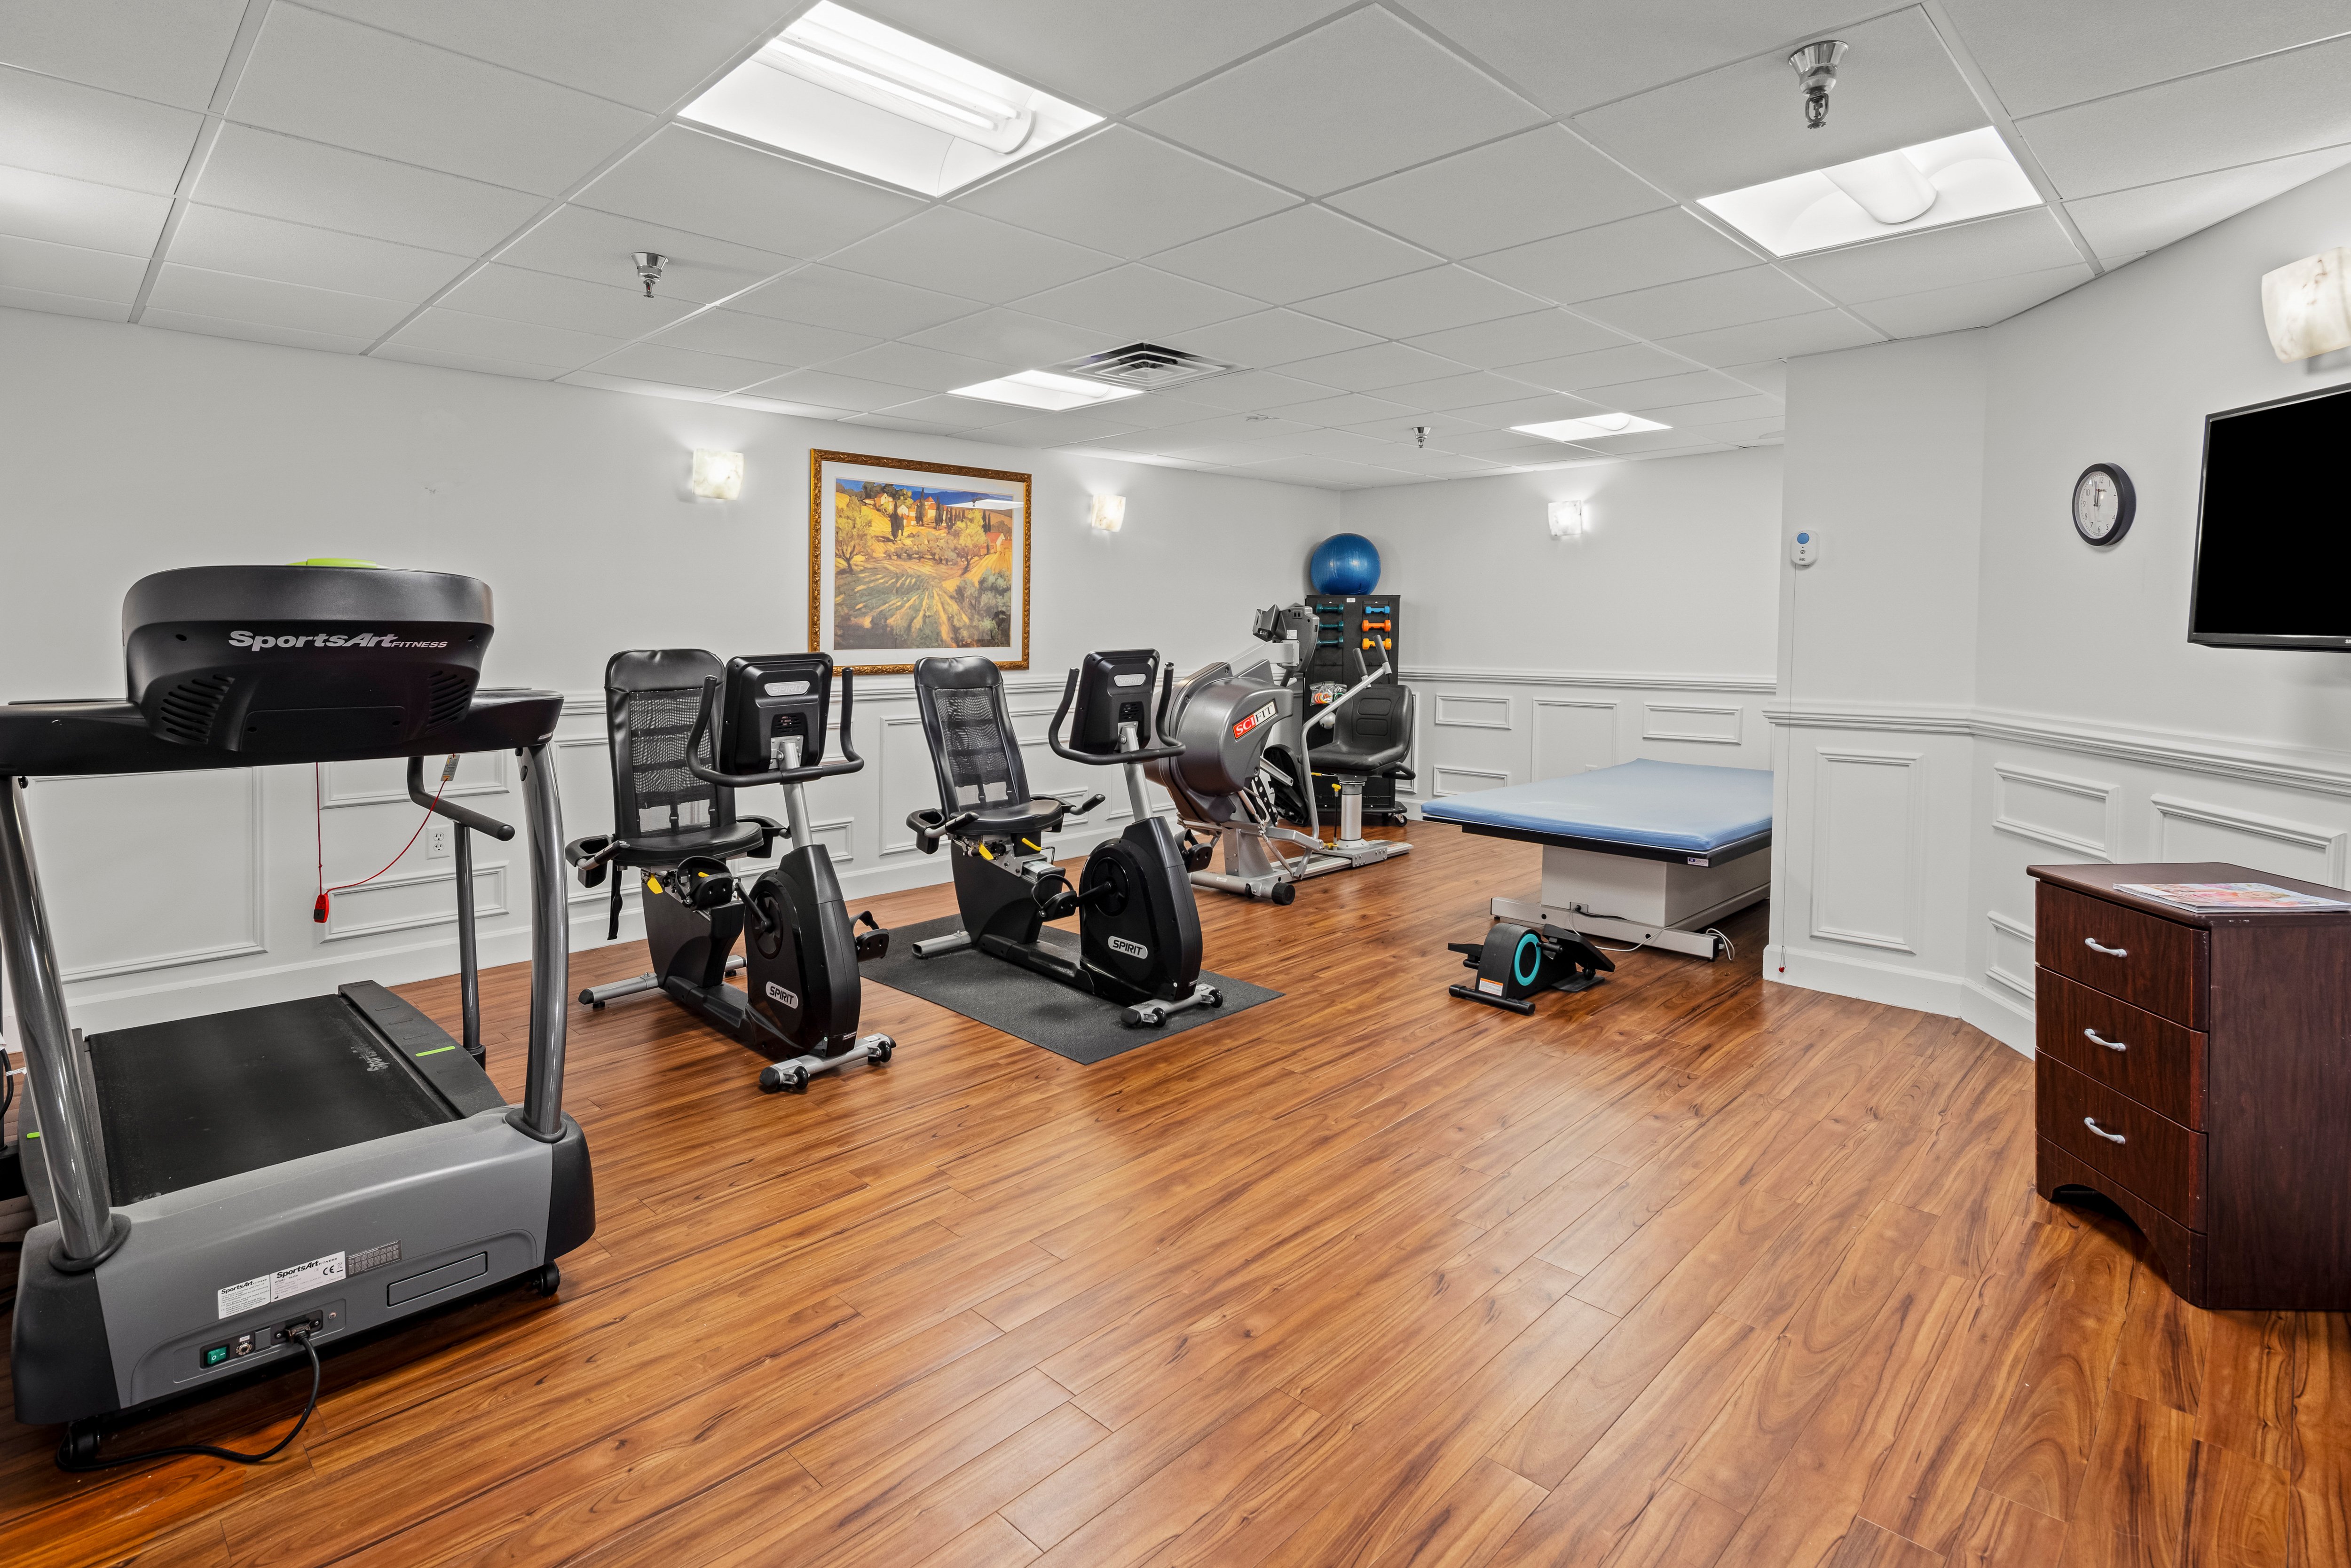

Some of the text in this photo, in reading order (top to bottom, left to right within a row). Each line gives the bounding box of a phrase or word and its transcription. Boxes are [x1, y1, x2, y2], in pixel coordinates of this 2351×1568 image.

[229, 630, 398, 651] SportsArt
[772, 685, 803, 693] SPIRIT
[1112, 939, 1143, 955] SPIRIT
[770, 986, 795, 1004] SPIRIT
[276, 1261, 319, 1278] SportsArt
[221, 1280, 253, 1294] SportsArt
